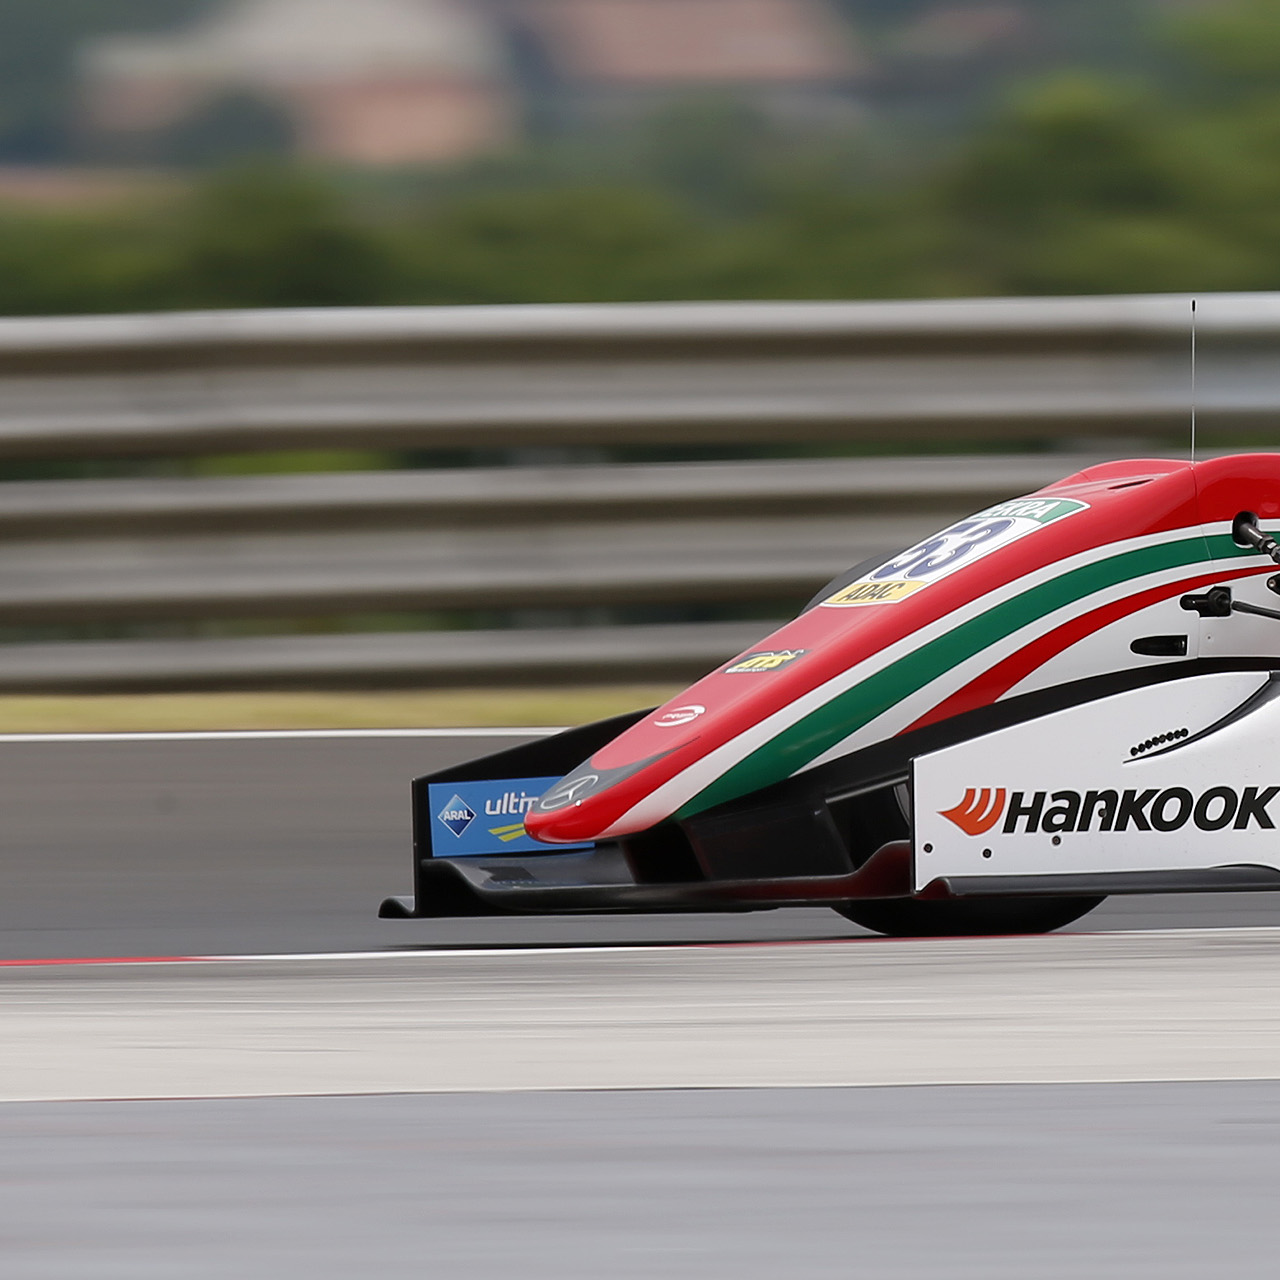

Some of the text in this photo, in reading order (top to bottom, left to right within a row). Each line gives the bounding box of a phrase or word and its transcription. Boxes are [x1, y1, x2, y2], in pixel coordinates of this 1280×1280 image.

[868, 517, 1016, 581] 53
[837, 582, 907, 602] ADAC
[443, 809, 472, 821] ARAL
